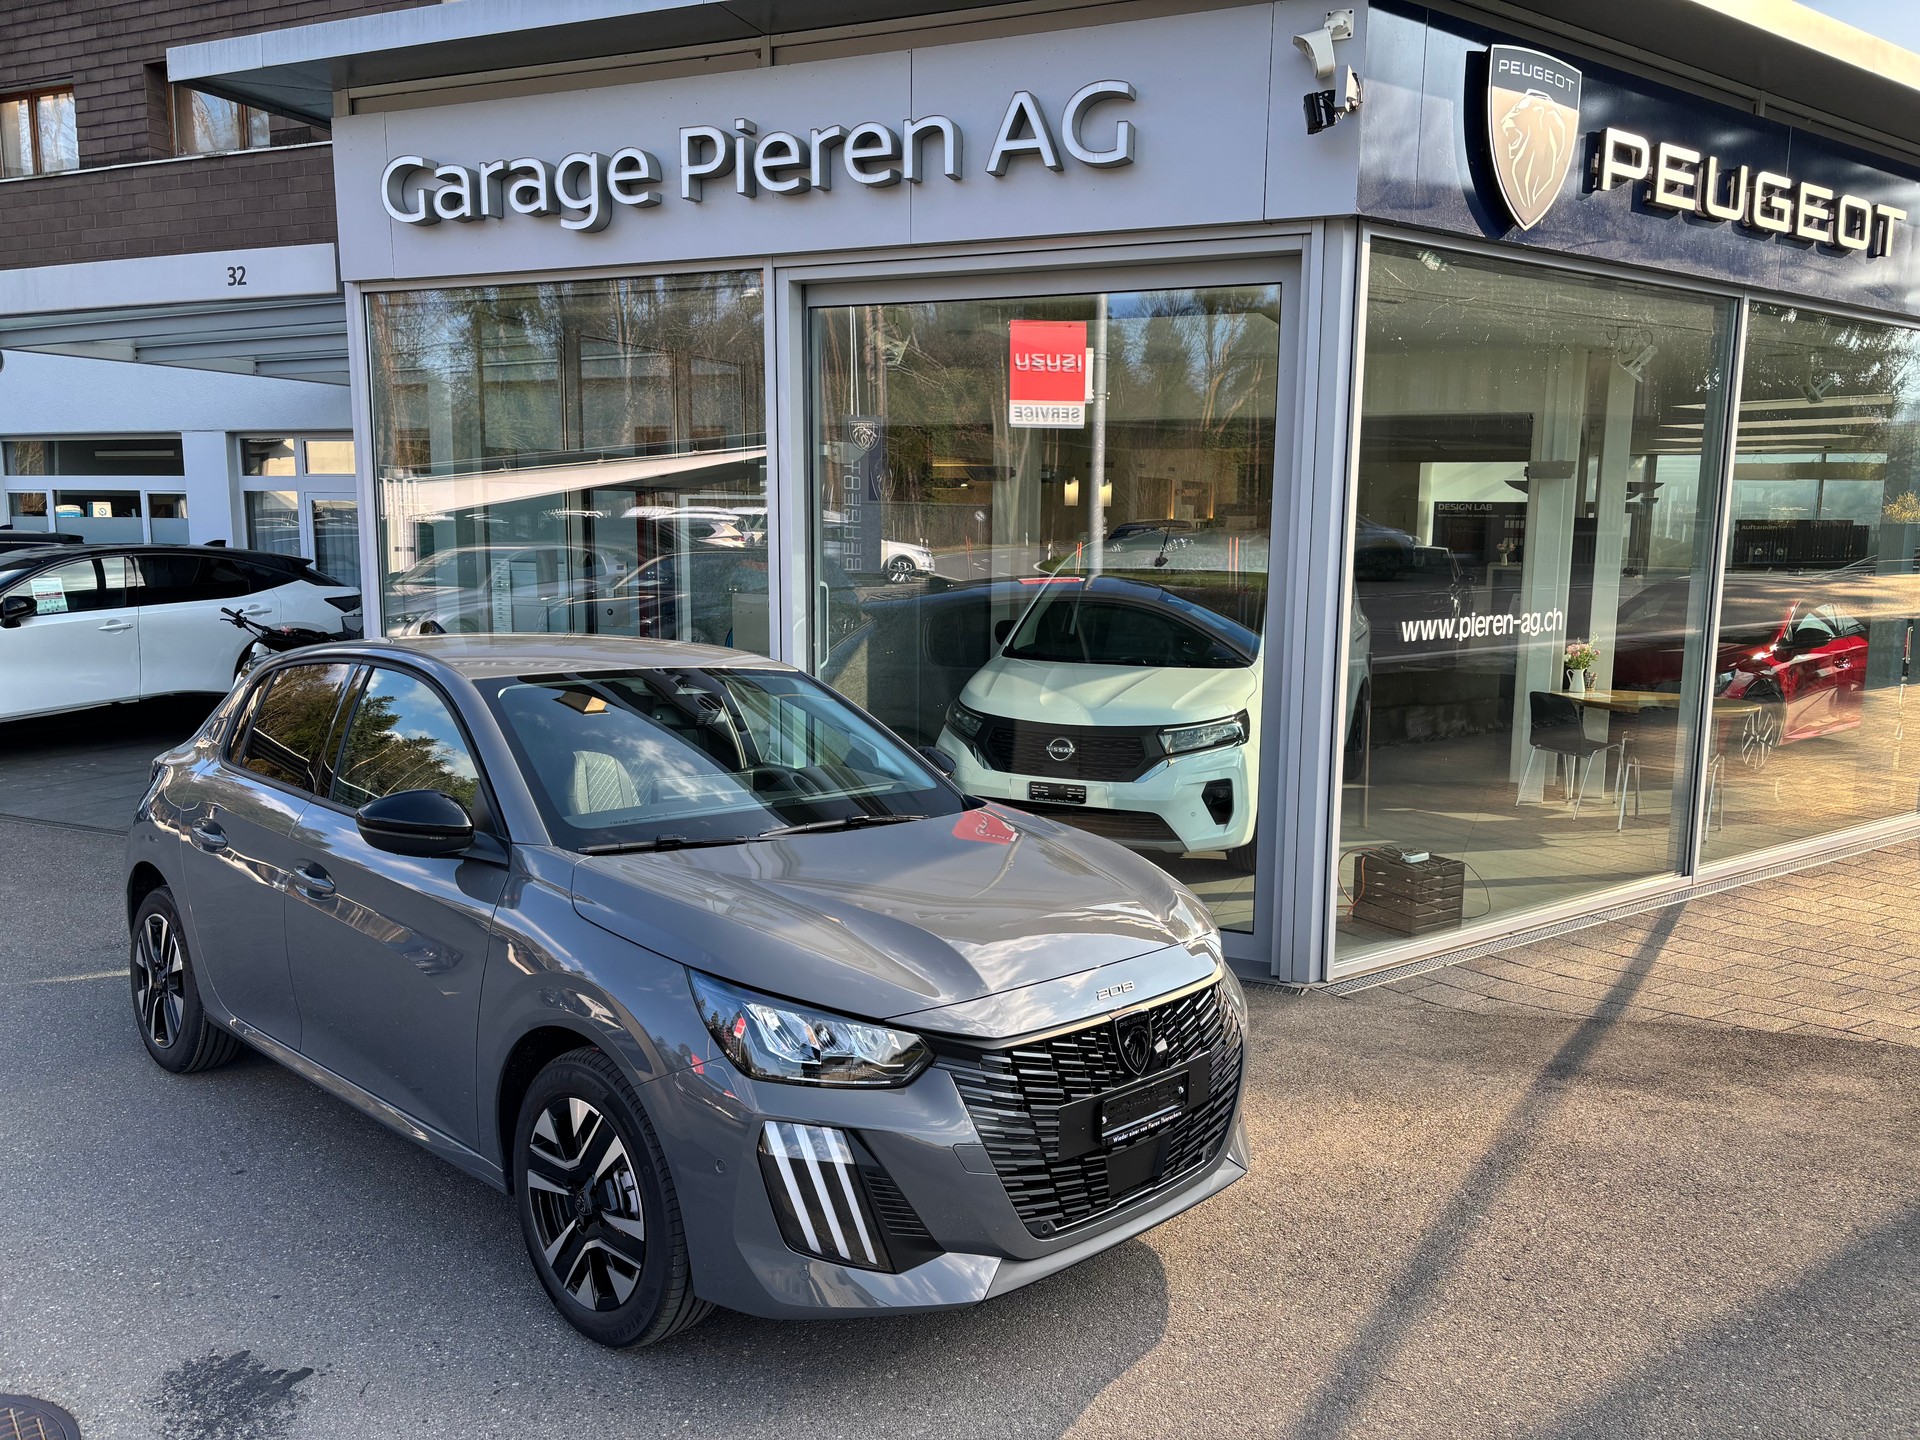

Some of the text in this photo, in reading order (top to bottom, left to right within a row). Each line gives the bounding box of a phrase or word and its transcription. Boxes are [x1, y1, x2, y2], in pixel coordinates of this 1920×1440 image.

[1498, 59, 1575, 92] PEUGEOT
[380, 79, 1137, 233] Garage Pieren AG
[1601, 127, 1907, 257] PEUGEOT
[227, 265, 247, 287] 32
[1438, 503, 1493, 511] DESIGN LAB
[1401, 607, 1563, 642] www.pieren-ag.ch
[1096, 980, 1135, 1001] 208
